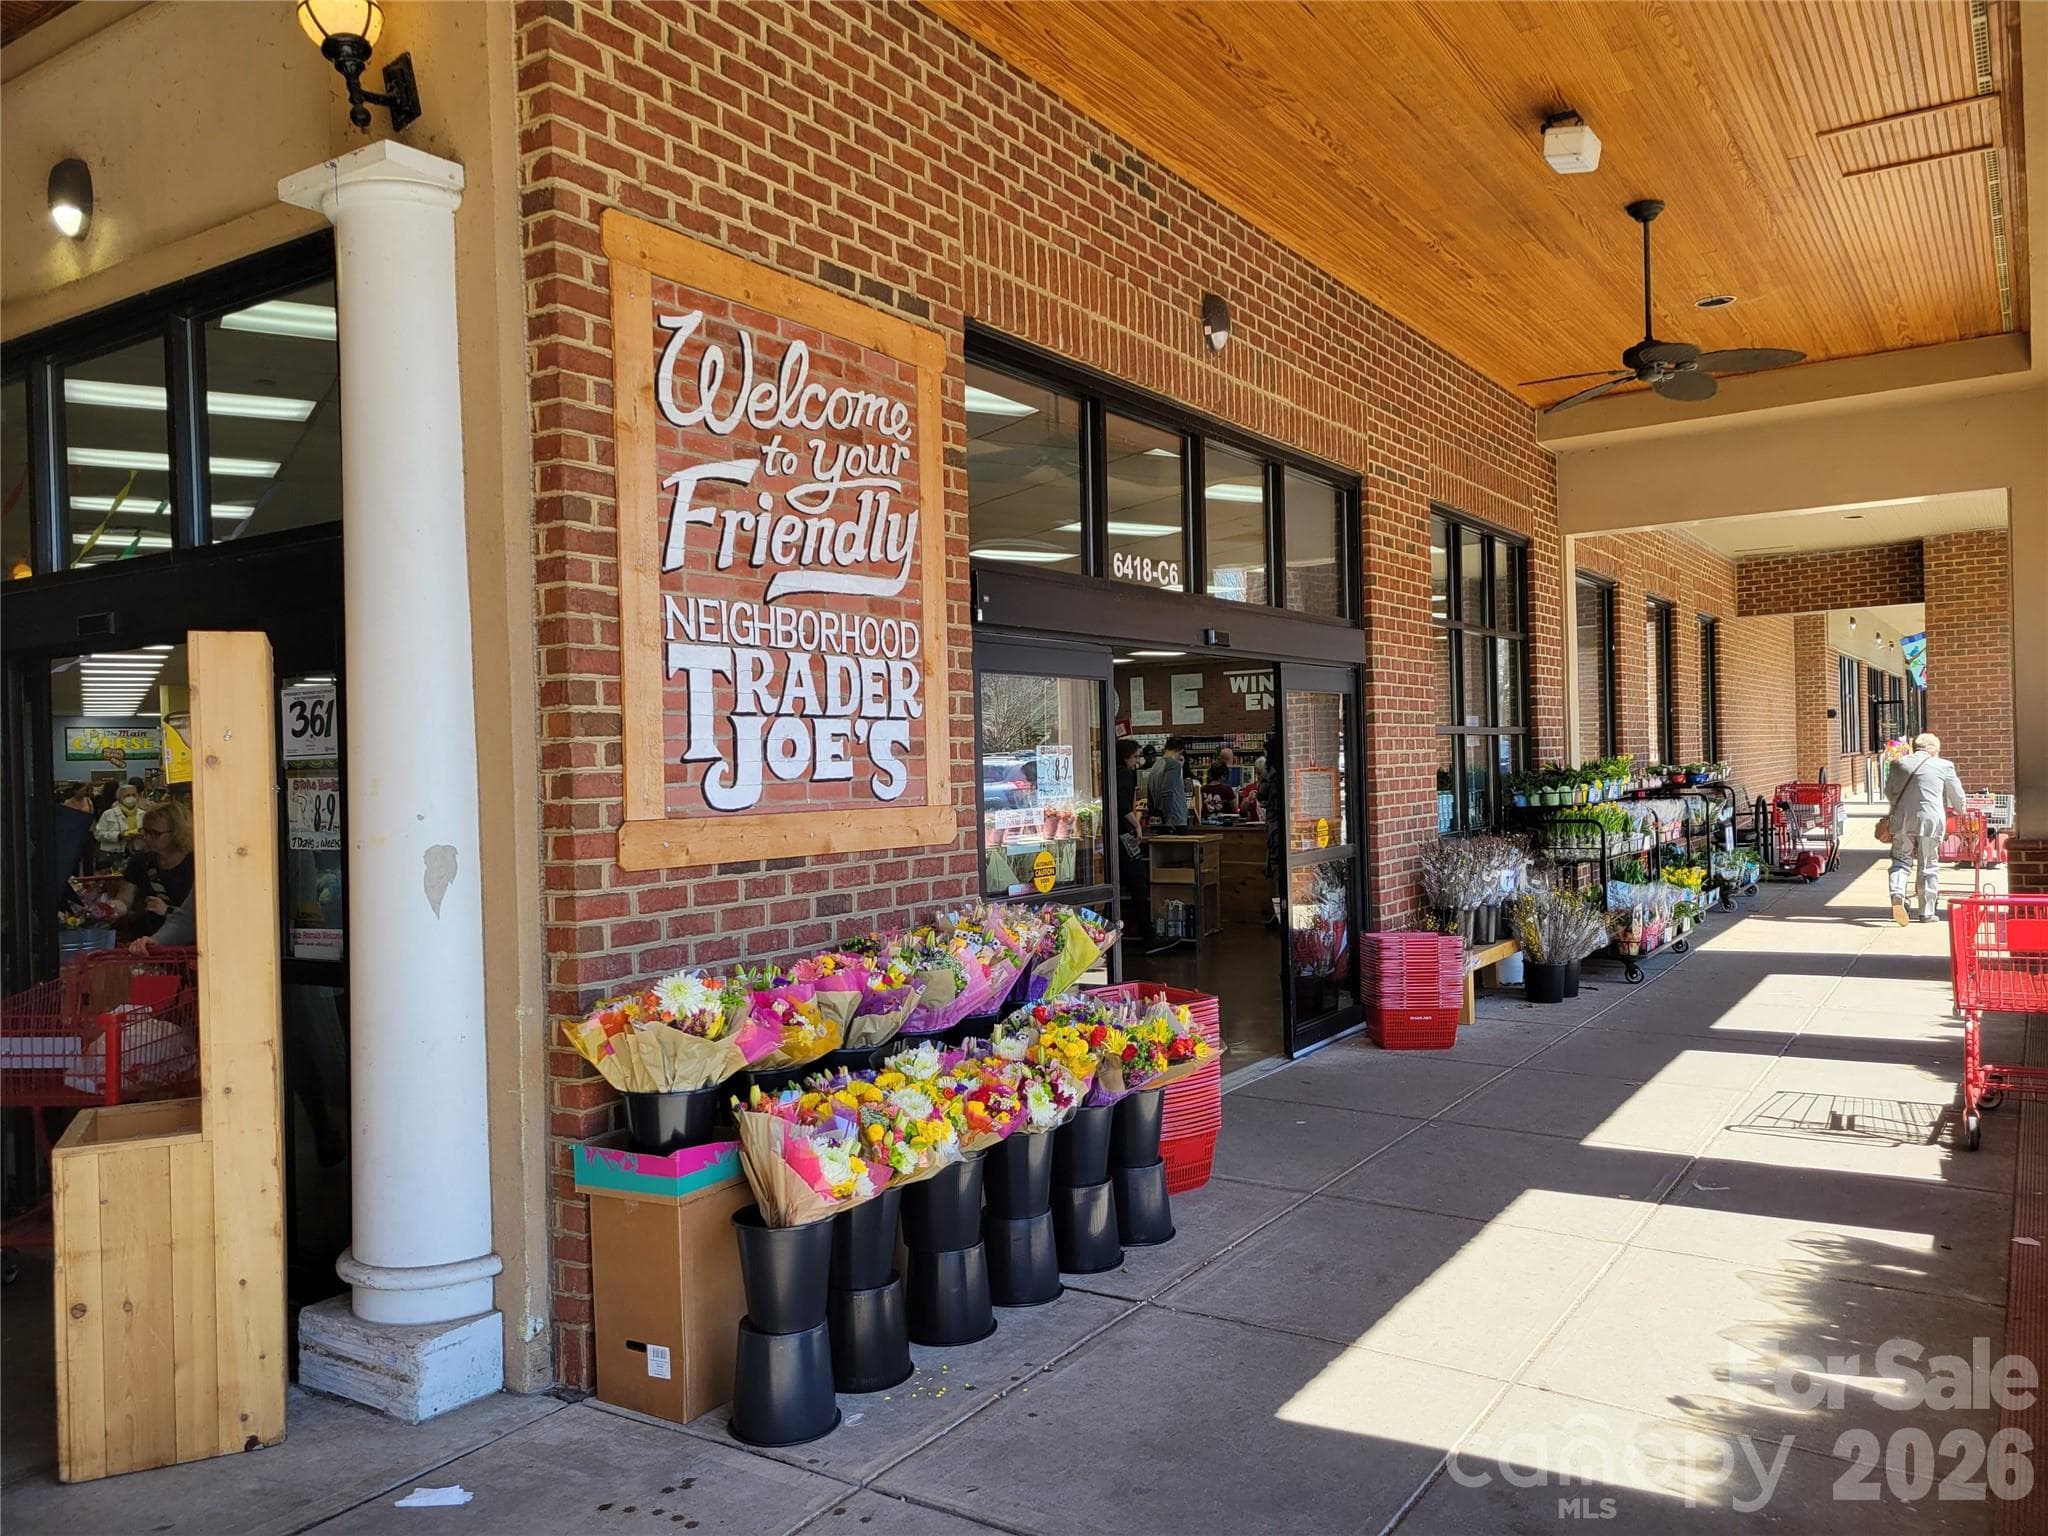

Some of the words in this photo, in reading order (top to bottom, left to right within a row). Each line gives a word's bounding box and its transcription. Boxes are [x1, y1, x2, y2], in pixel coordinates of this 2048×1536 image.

[657, 310, 912, 441] Welcome
[761, 435, 798, 476] to
[662, 459, 919, 604] Friendly
[1113, 552, 1179, 585] 6418-C6
[664, 594, 920, 660] NEIGHBORHOOD
[666, 642, 923, 763] TRADER
[1113, 672, 1205, 727] LE
[72, 736, 155, 751] CURSE
[701, 715, 911, 812] JOE'S
